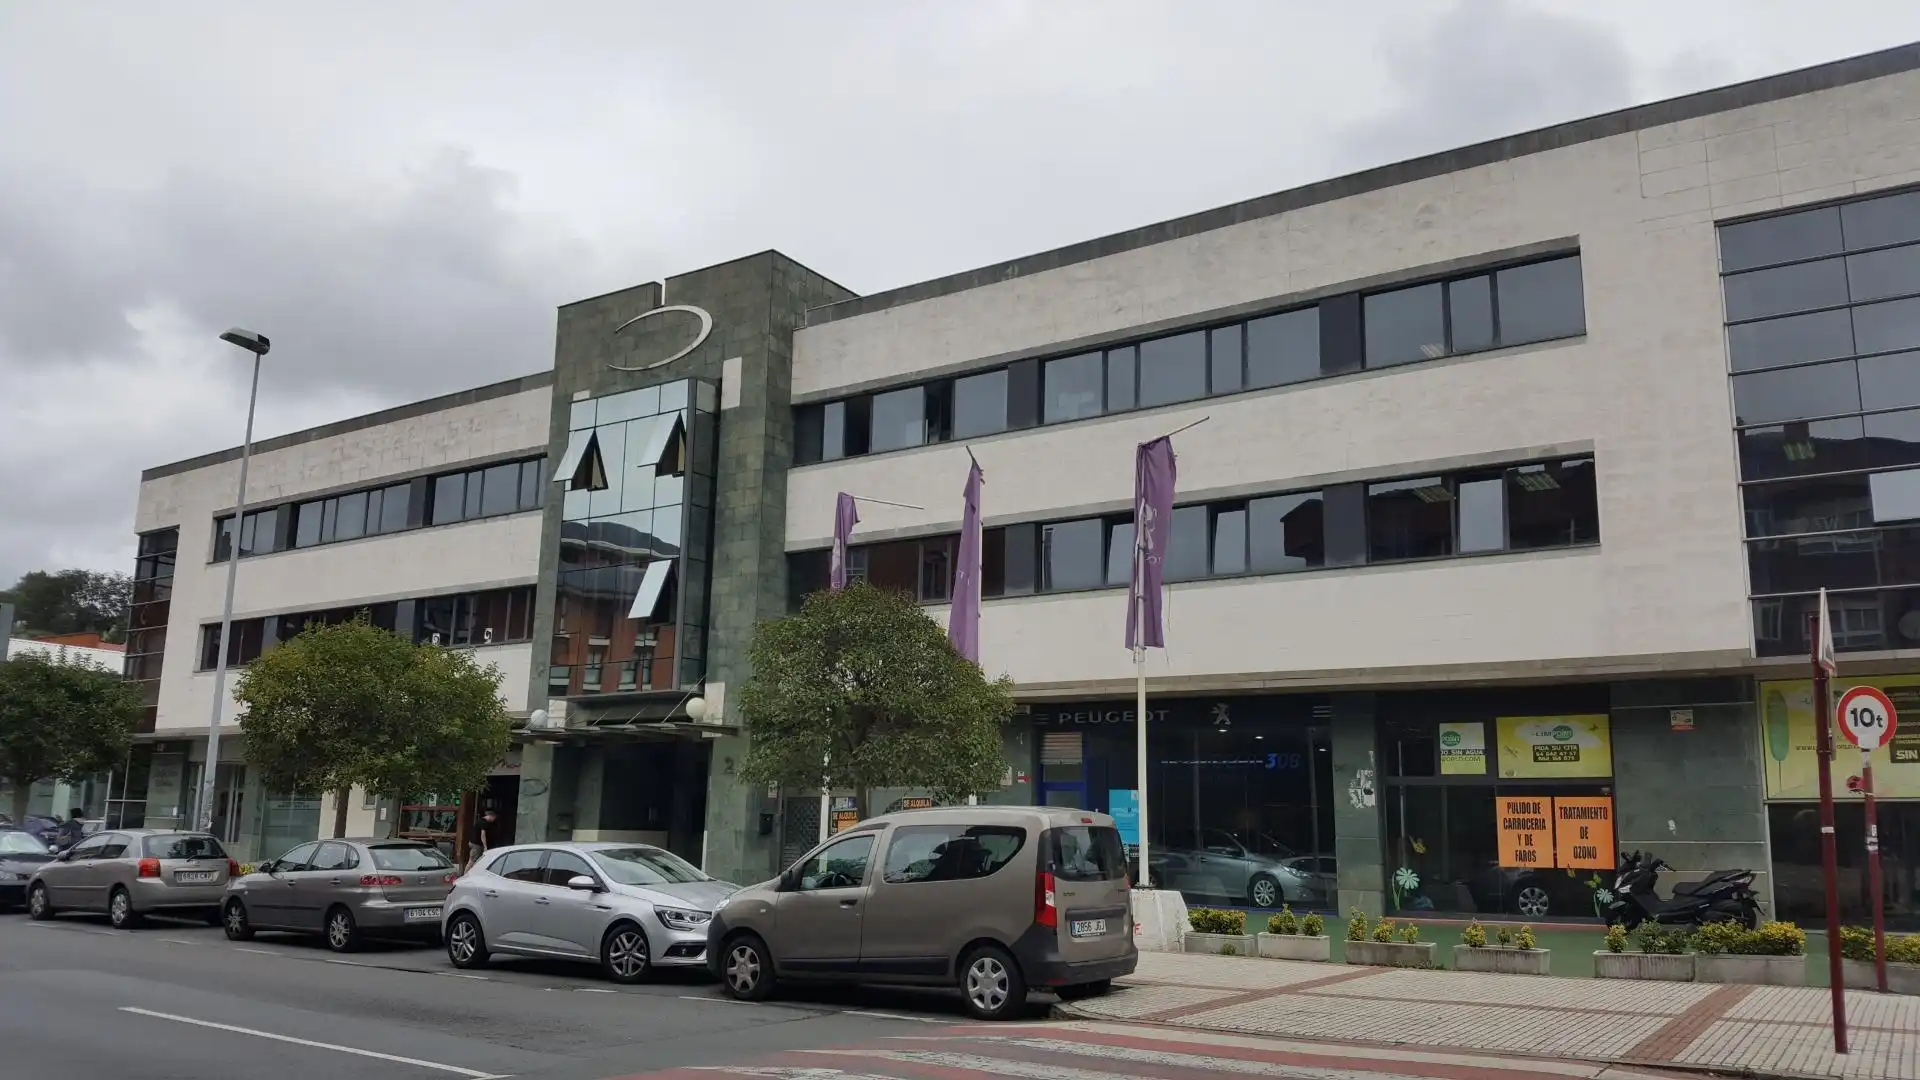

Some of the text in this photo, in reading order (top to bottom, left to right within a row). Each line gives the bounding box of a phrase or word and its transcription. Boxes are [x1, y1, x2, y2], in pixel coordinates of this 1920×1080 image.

[1896, 750, 1919, 760] SIN
[1507, 802, 1541, 814] PULIDO DE
[1559, 807, 1608, 820] TRATAMIENTO
[1503, 818, 1546, 830] CARROCERIA
[1580, 826, 1589, 839] DE
[1517, 834, 1533, 846] Y DE
[1515, 850, 1537, 862] FAROS
[1573, 846, 1597, 860] OZONO
